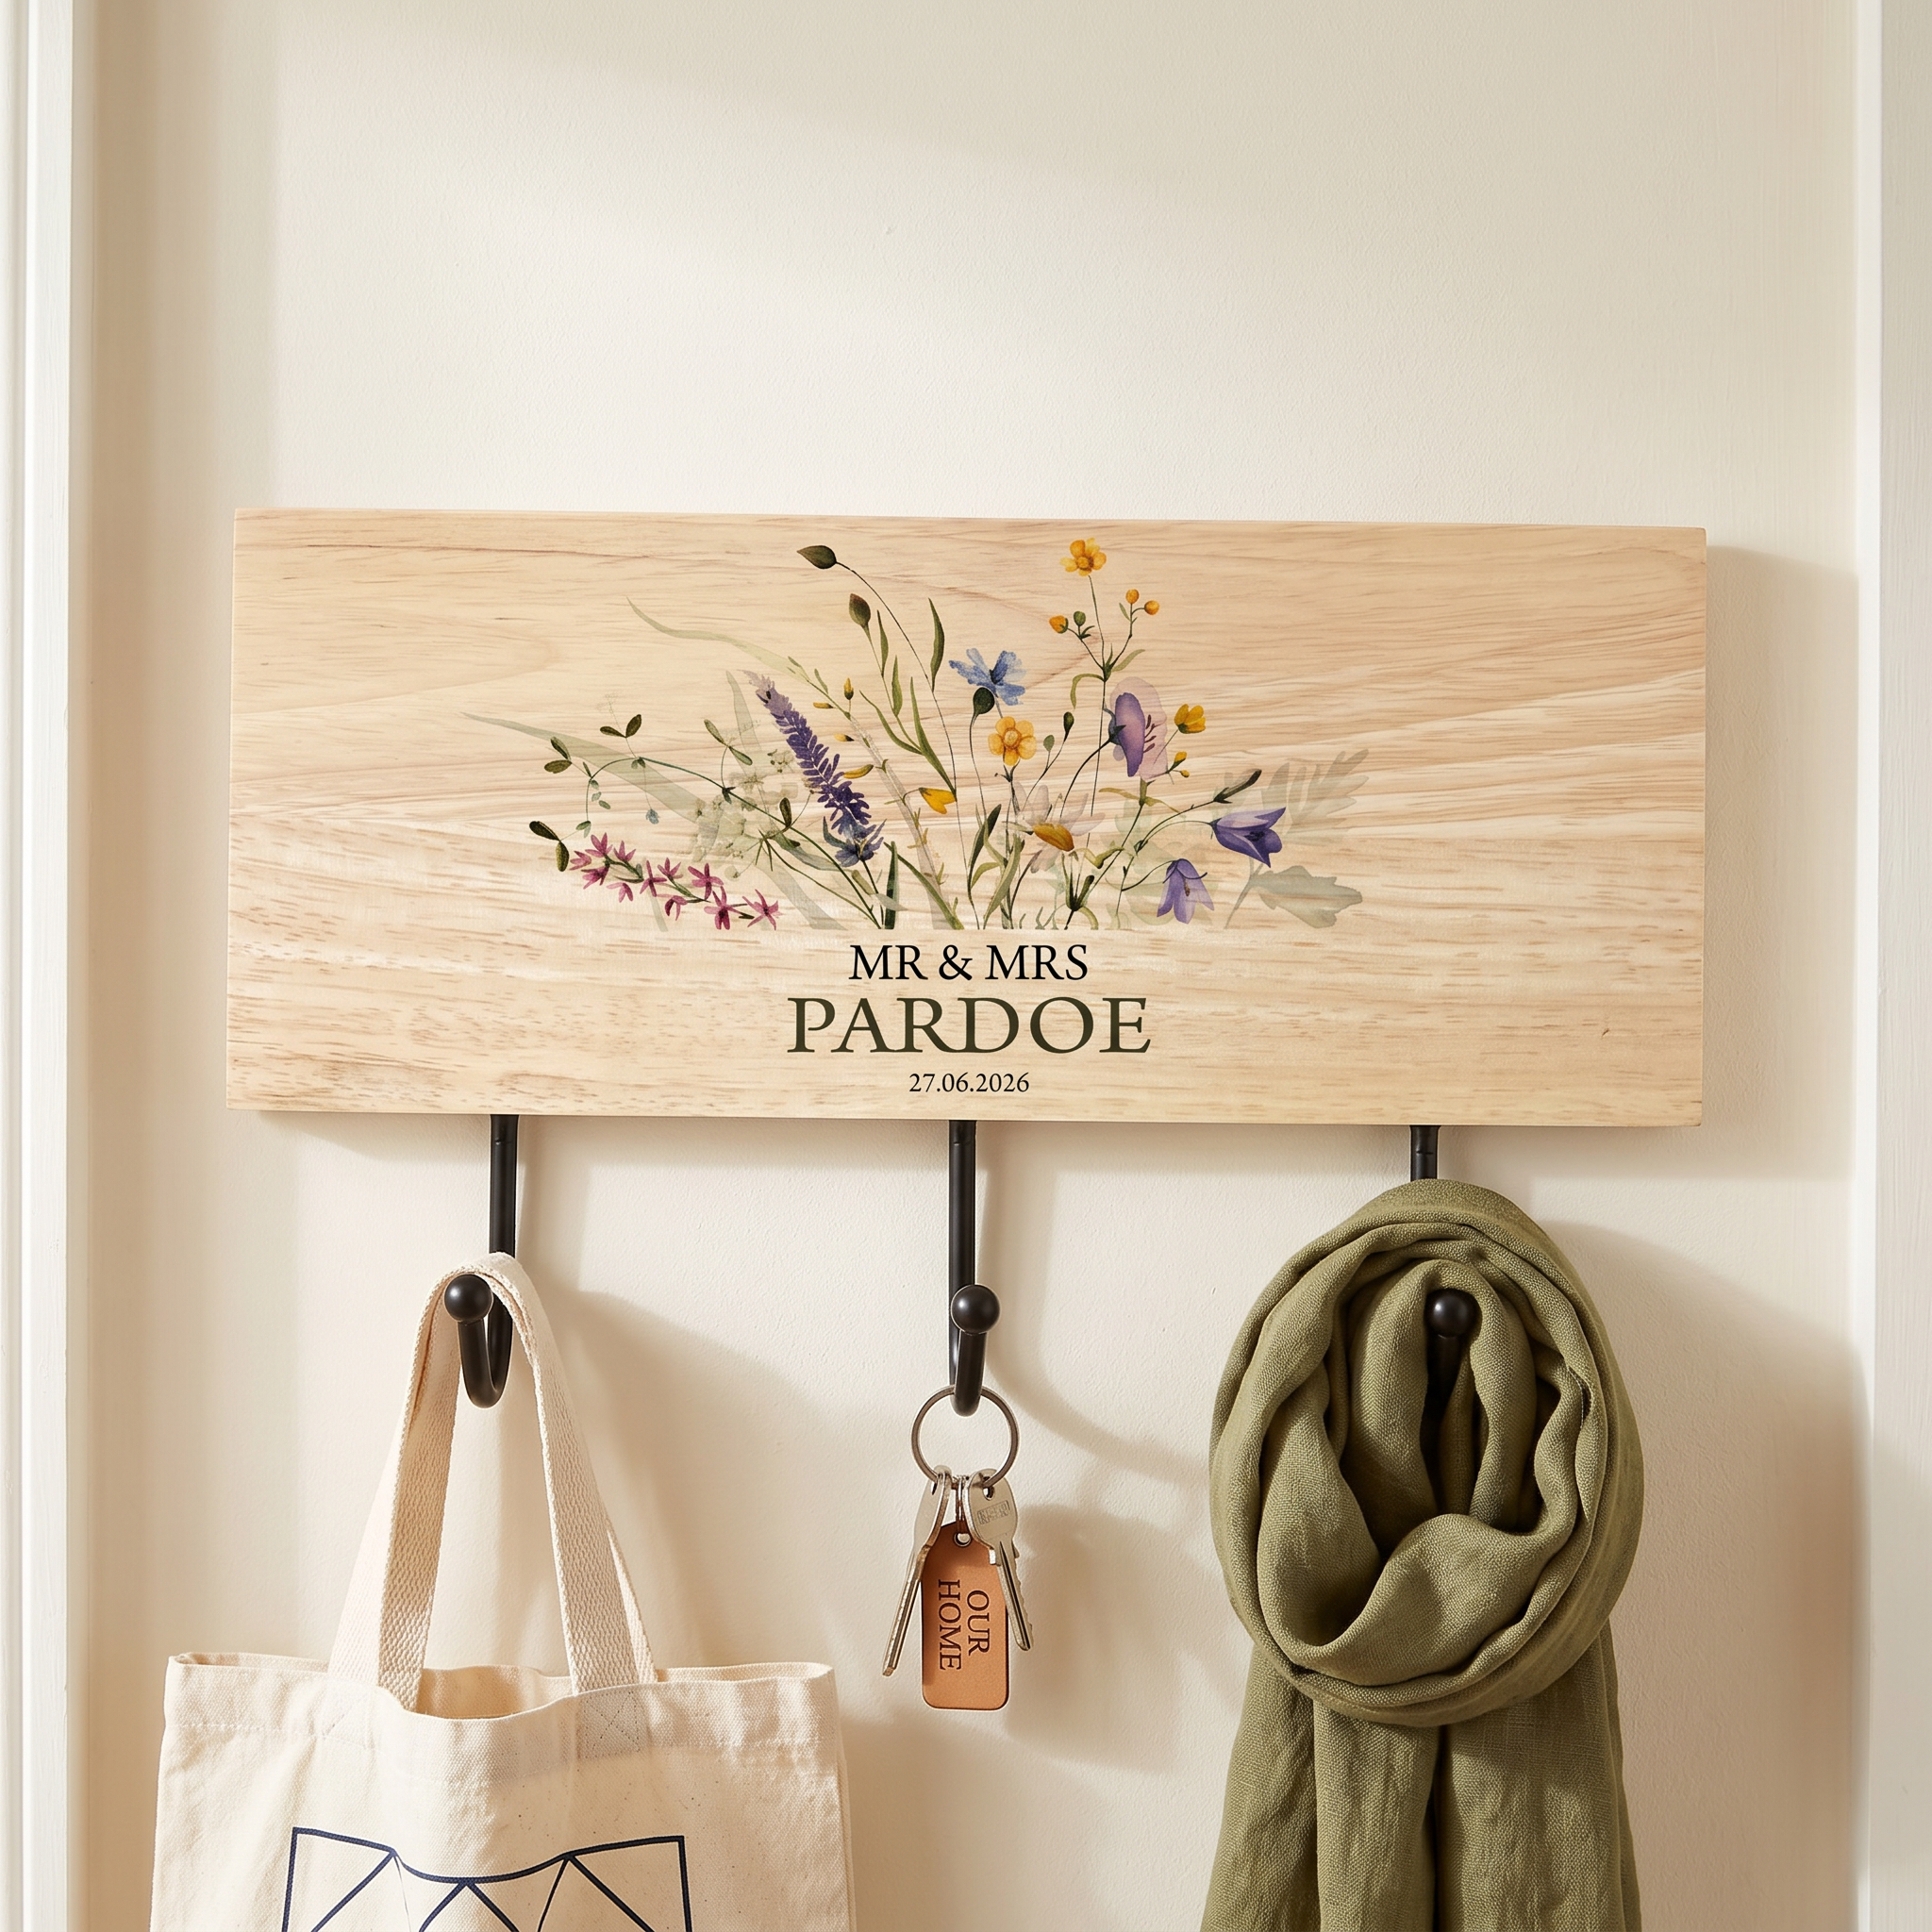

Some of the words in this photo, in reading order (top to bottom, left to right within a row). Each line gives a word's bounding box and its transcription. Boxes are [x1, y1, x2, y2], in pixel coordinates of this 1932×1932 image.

[848, 944, 928, 980] MR
[938, 944, 973, 981] &
[985, 943, 1089, 981] MRS
[787, 996, 1151, 1054] PARDOE
[908, 1072, 1030, 1093] 27.06.2026
[938, 1578, 962, 1671] HOME
[966, 1590, 991, 1657] OUR
